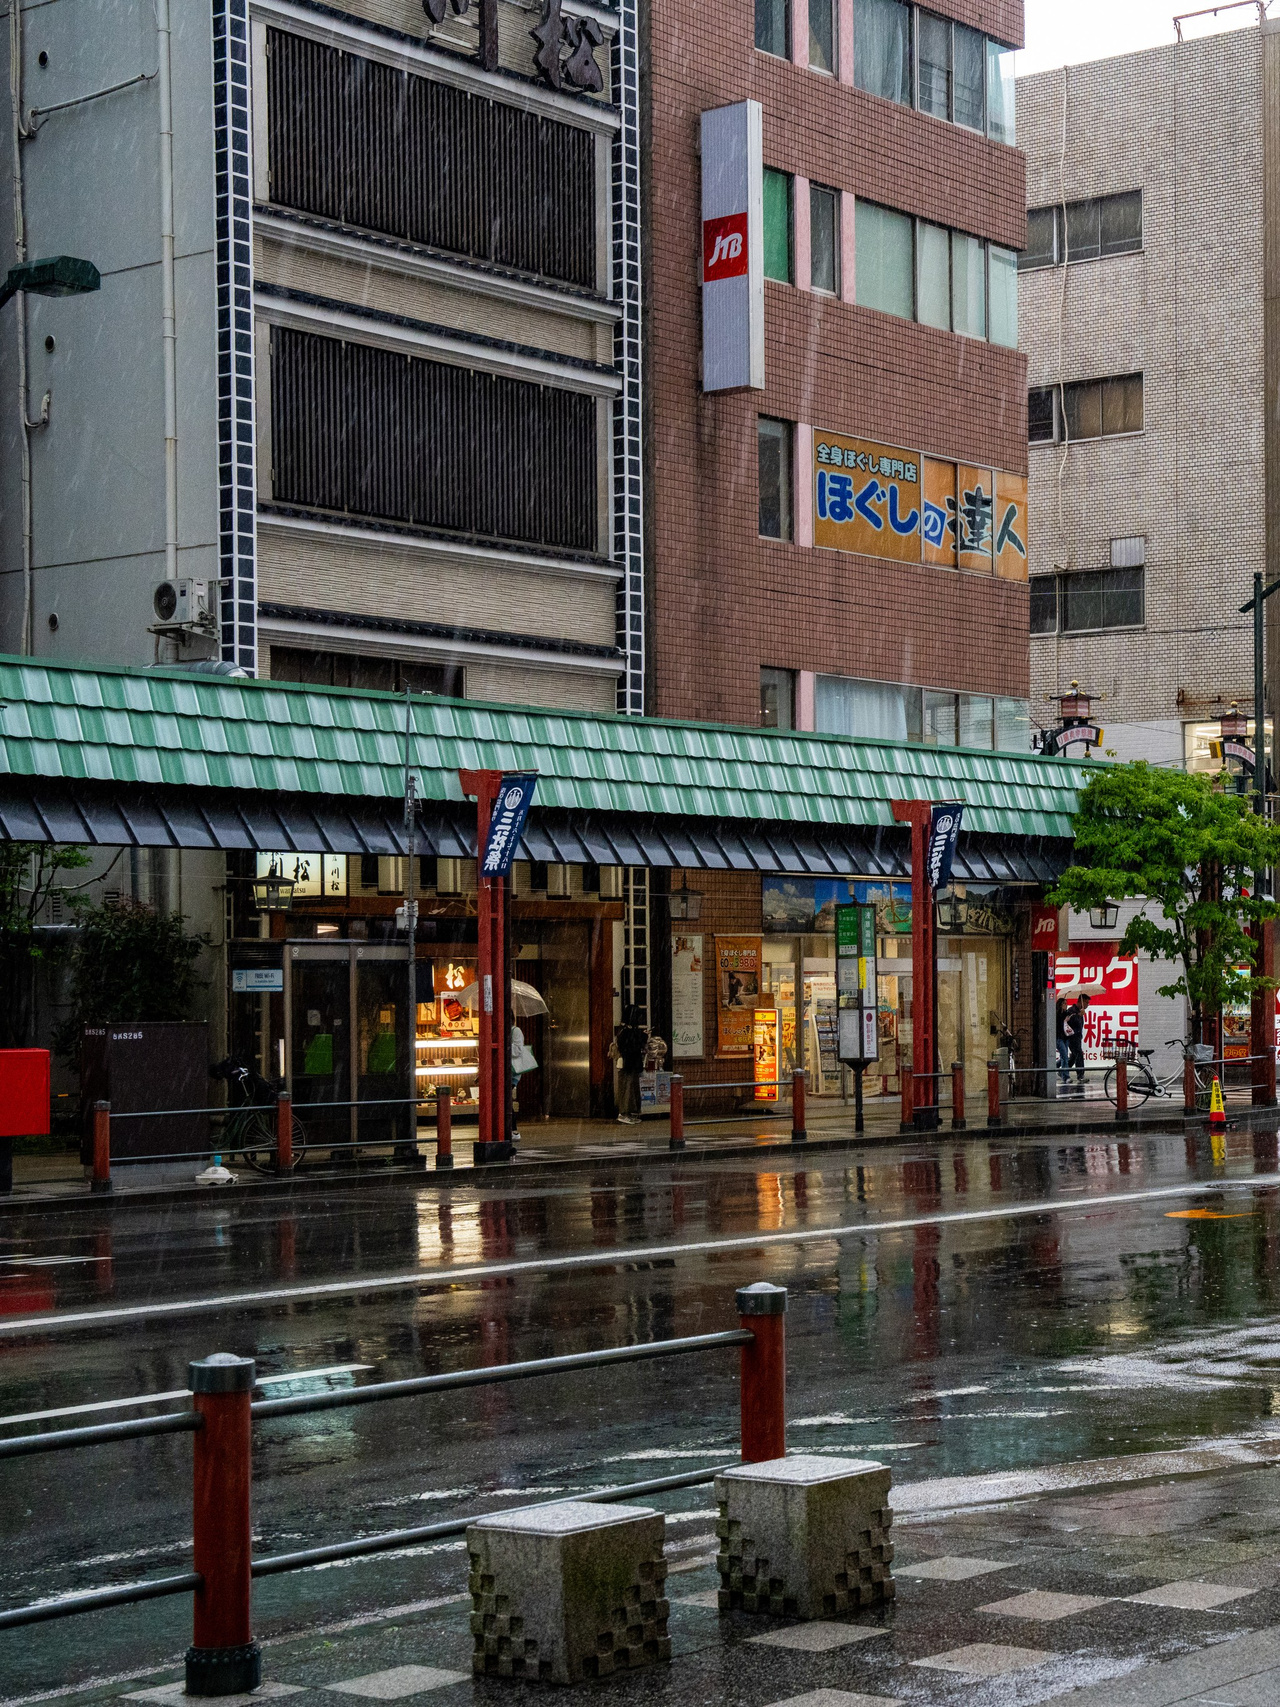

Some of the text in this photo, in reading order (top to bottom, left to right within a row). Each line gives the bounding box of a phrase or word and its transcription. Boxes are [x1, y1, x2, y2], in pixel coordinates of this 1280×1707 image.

[708, 232, 743, 267] JTB
[816, 443, 918, 483] 全身ほぐし専門店
[816, 469, 1026, 559] ほぐしの達人
[1034, 918, 1055, 935] JTB
